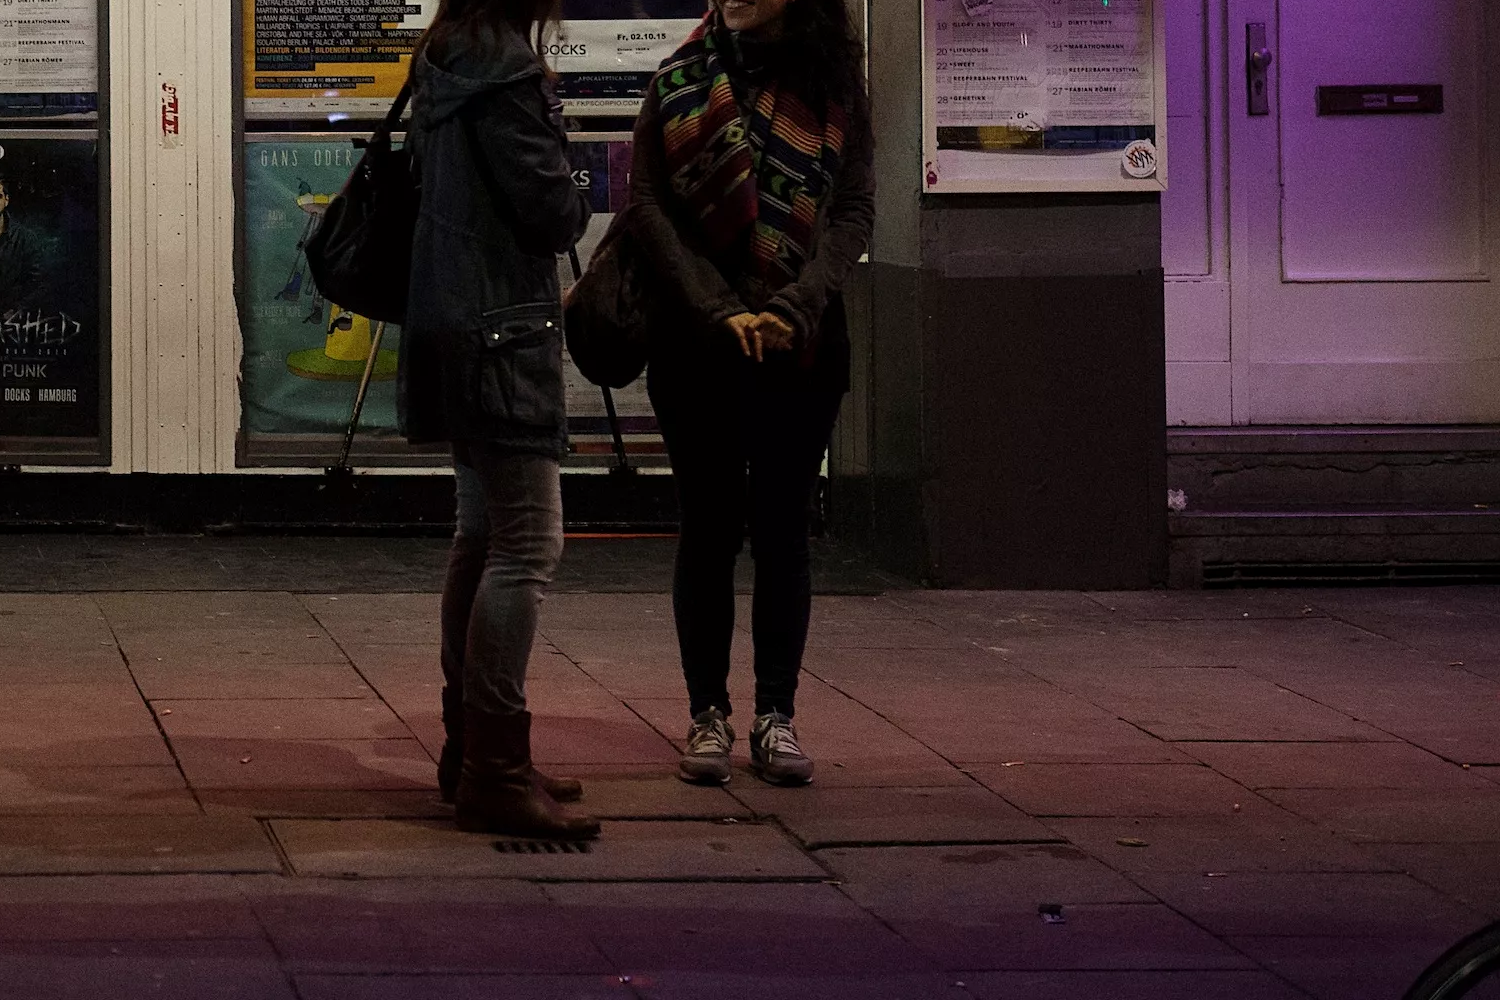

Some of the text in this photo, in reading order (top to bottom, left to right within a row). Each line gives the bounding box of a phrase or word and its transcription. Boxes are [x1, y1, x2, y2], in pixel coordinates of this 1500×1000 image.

[260, 149, 353, 167] GANS ODER
[3, 363, 47, 378] PUNK
[4, 387, 30, 402] DOCKS
[38, 388, 77, 402] HAMBURG
